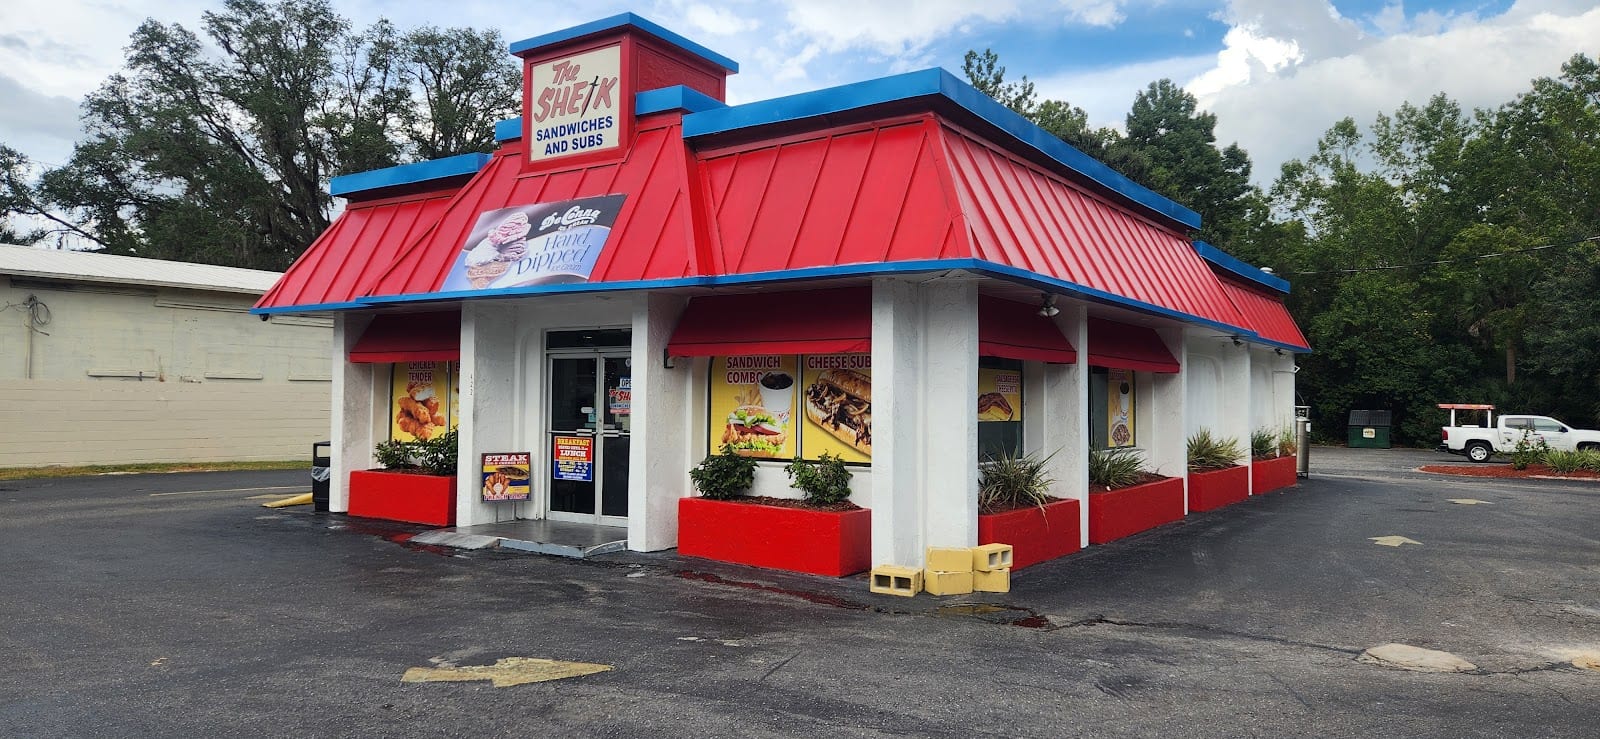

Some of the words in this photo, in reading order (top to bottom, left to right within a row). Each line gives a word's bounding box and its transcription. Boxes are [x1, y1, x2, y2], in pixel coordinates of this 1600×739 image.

[534, 76, 617, 123] SHEIK
[536, 116, 613, 141] SANDWICHES
[545, 140, 568, 155] AND
[572, 133, 603, 150] SUBS
[544, 228, 592, 252] Hand
[517, 244, 592, 275] Dipped
[408, 361, 436, 370] CHICKEN
[726, 356, 781, 369] SANDWICH
[808, 356, 847, 369] CHEESE
[408, 372, 432, 382] TENDER
[485, 454, 528, 462] STEAK
